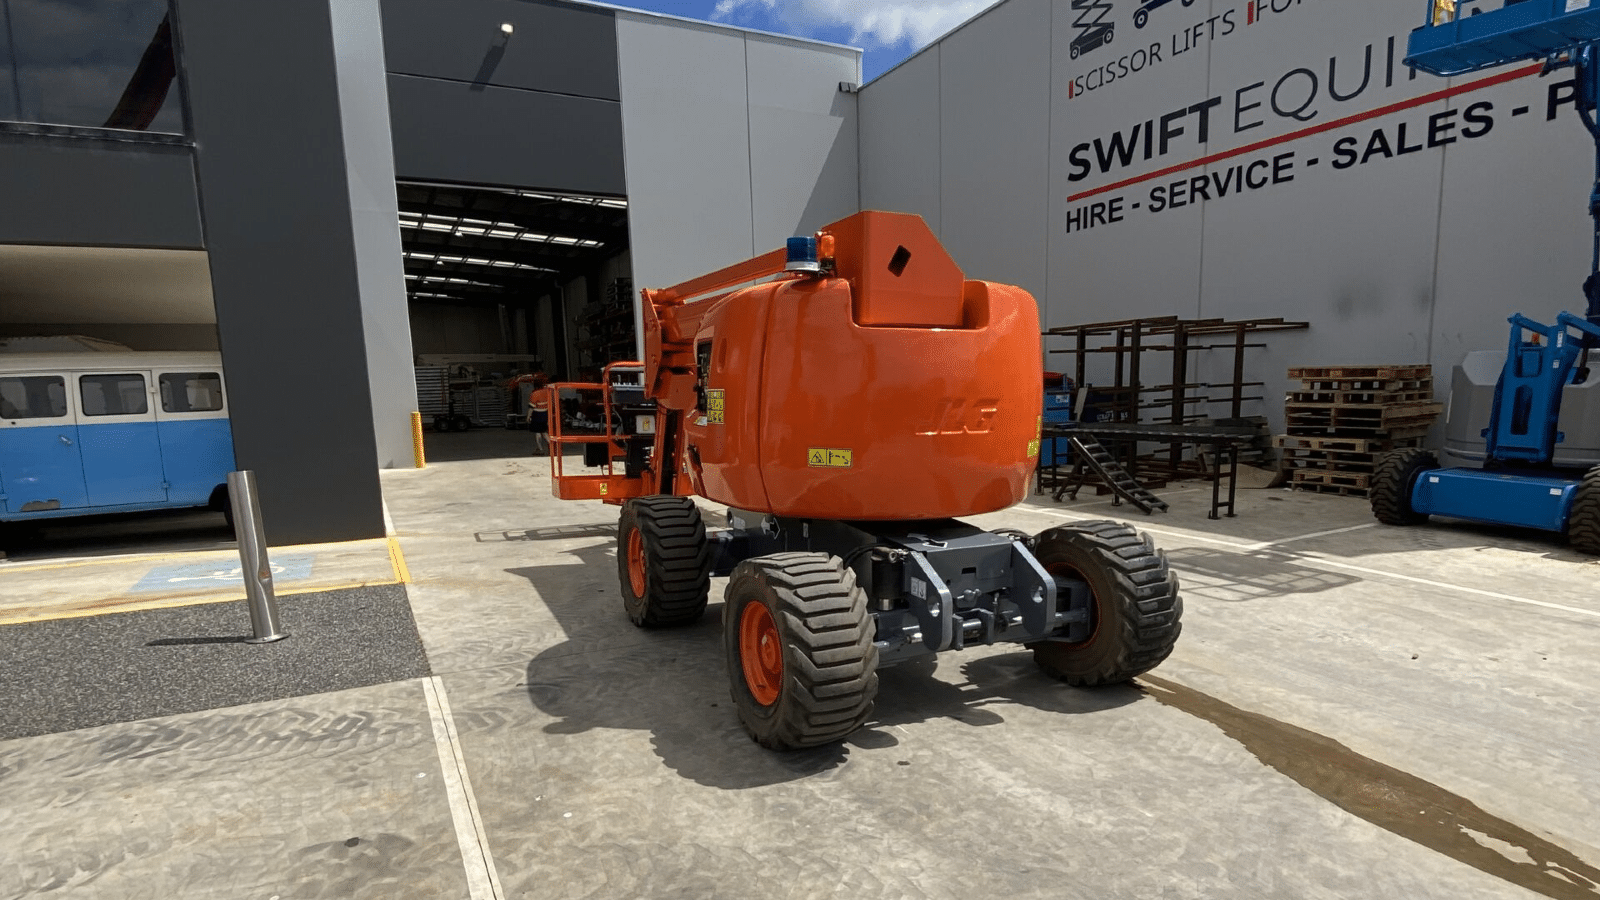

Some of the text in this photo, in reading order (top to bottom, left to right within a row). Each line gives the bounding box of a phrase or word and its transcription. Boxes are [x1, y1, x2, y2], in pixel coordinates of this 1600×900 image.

[1074, 9, 1236, 97] SCISSOR LIFTS
[1256, 0, 1302, 22] FO
[1067, 35, 1417, 182] SWIFT EQUI
[1066, 196, 1124, 233] HIRE
[1148, 151, 1295, 213] SERVICE
[1331, 101, 1494, 170] SALES
